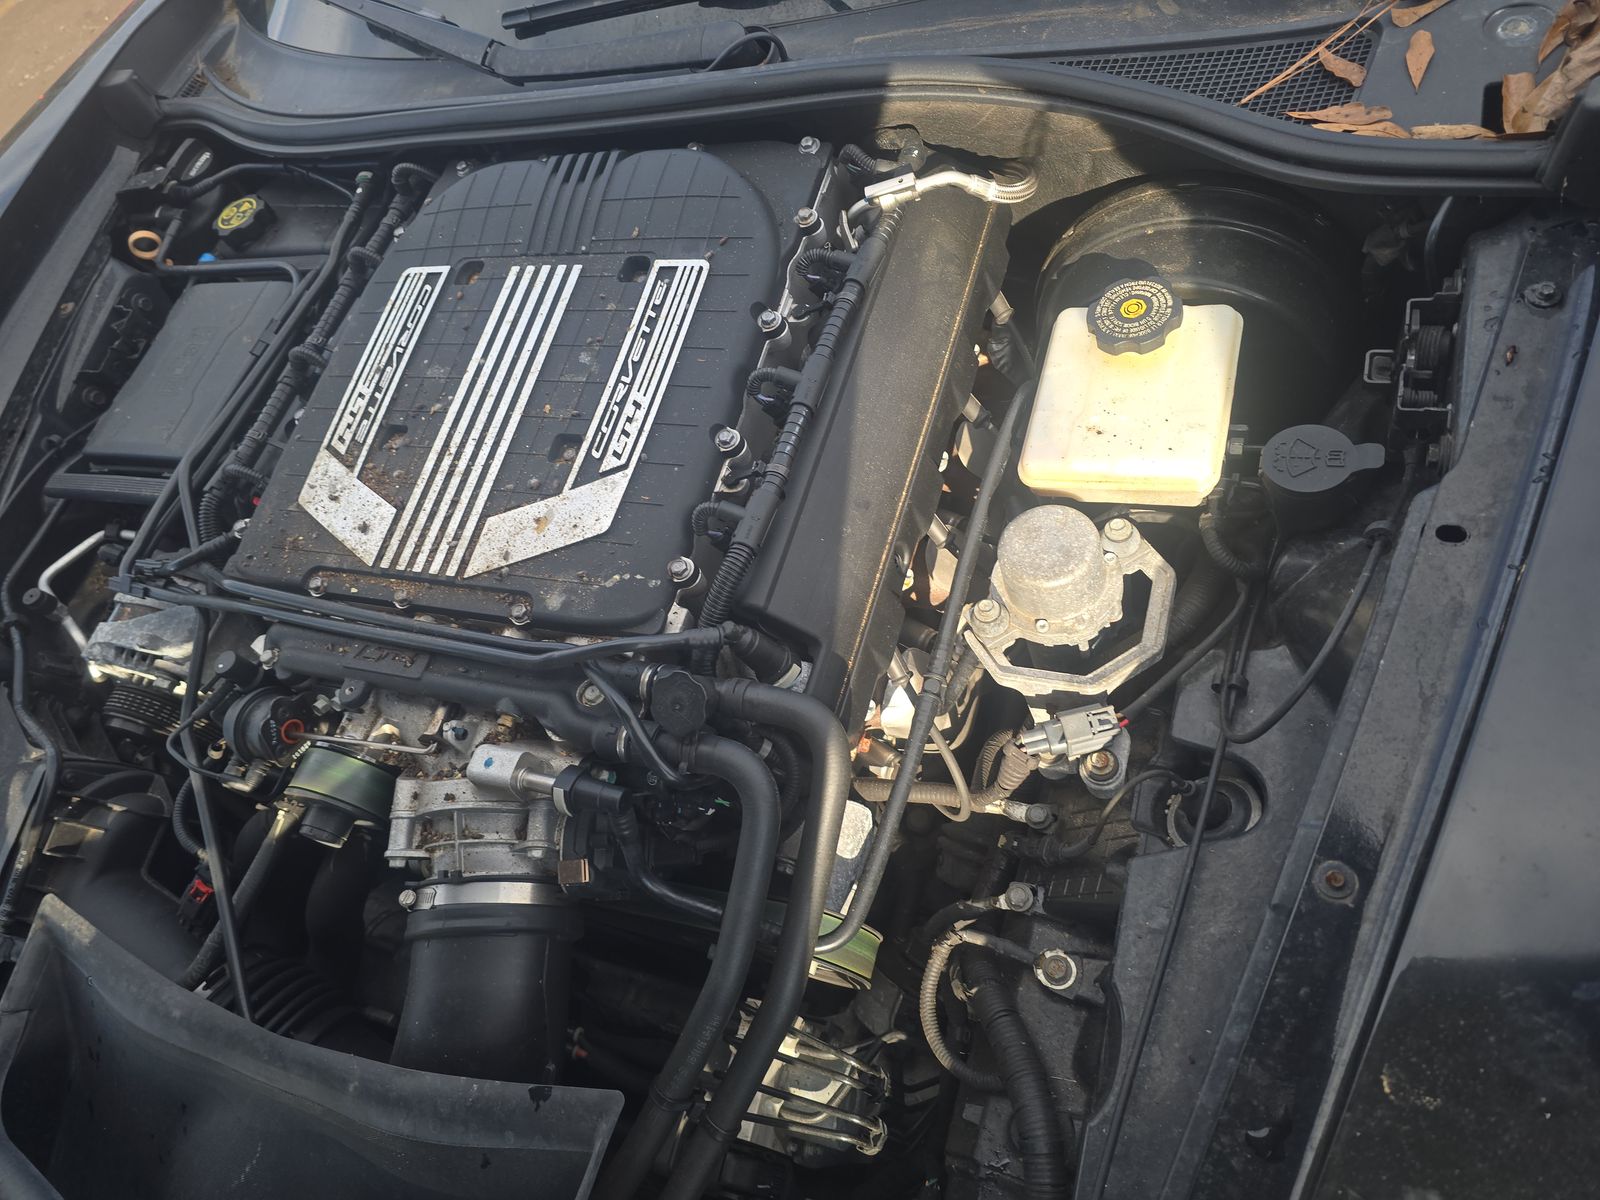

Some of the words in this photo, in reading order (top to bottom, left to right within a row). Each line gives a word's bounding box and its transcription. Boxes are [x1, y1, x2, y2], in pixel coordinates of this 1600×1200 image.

[338, 391, 366, 445] LT4
[355, 284, 432, 443] CORVETTE
[592, 279, 667, 459] CORVETTE
[612, 400, 642, 461] LT4
